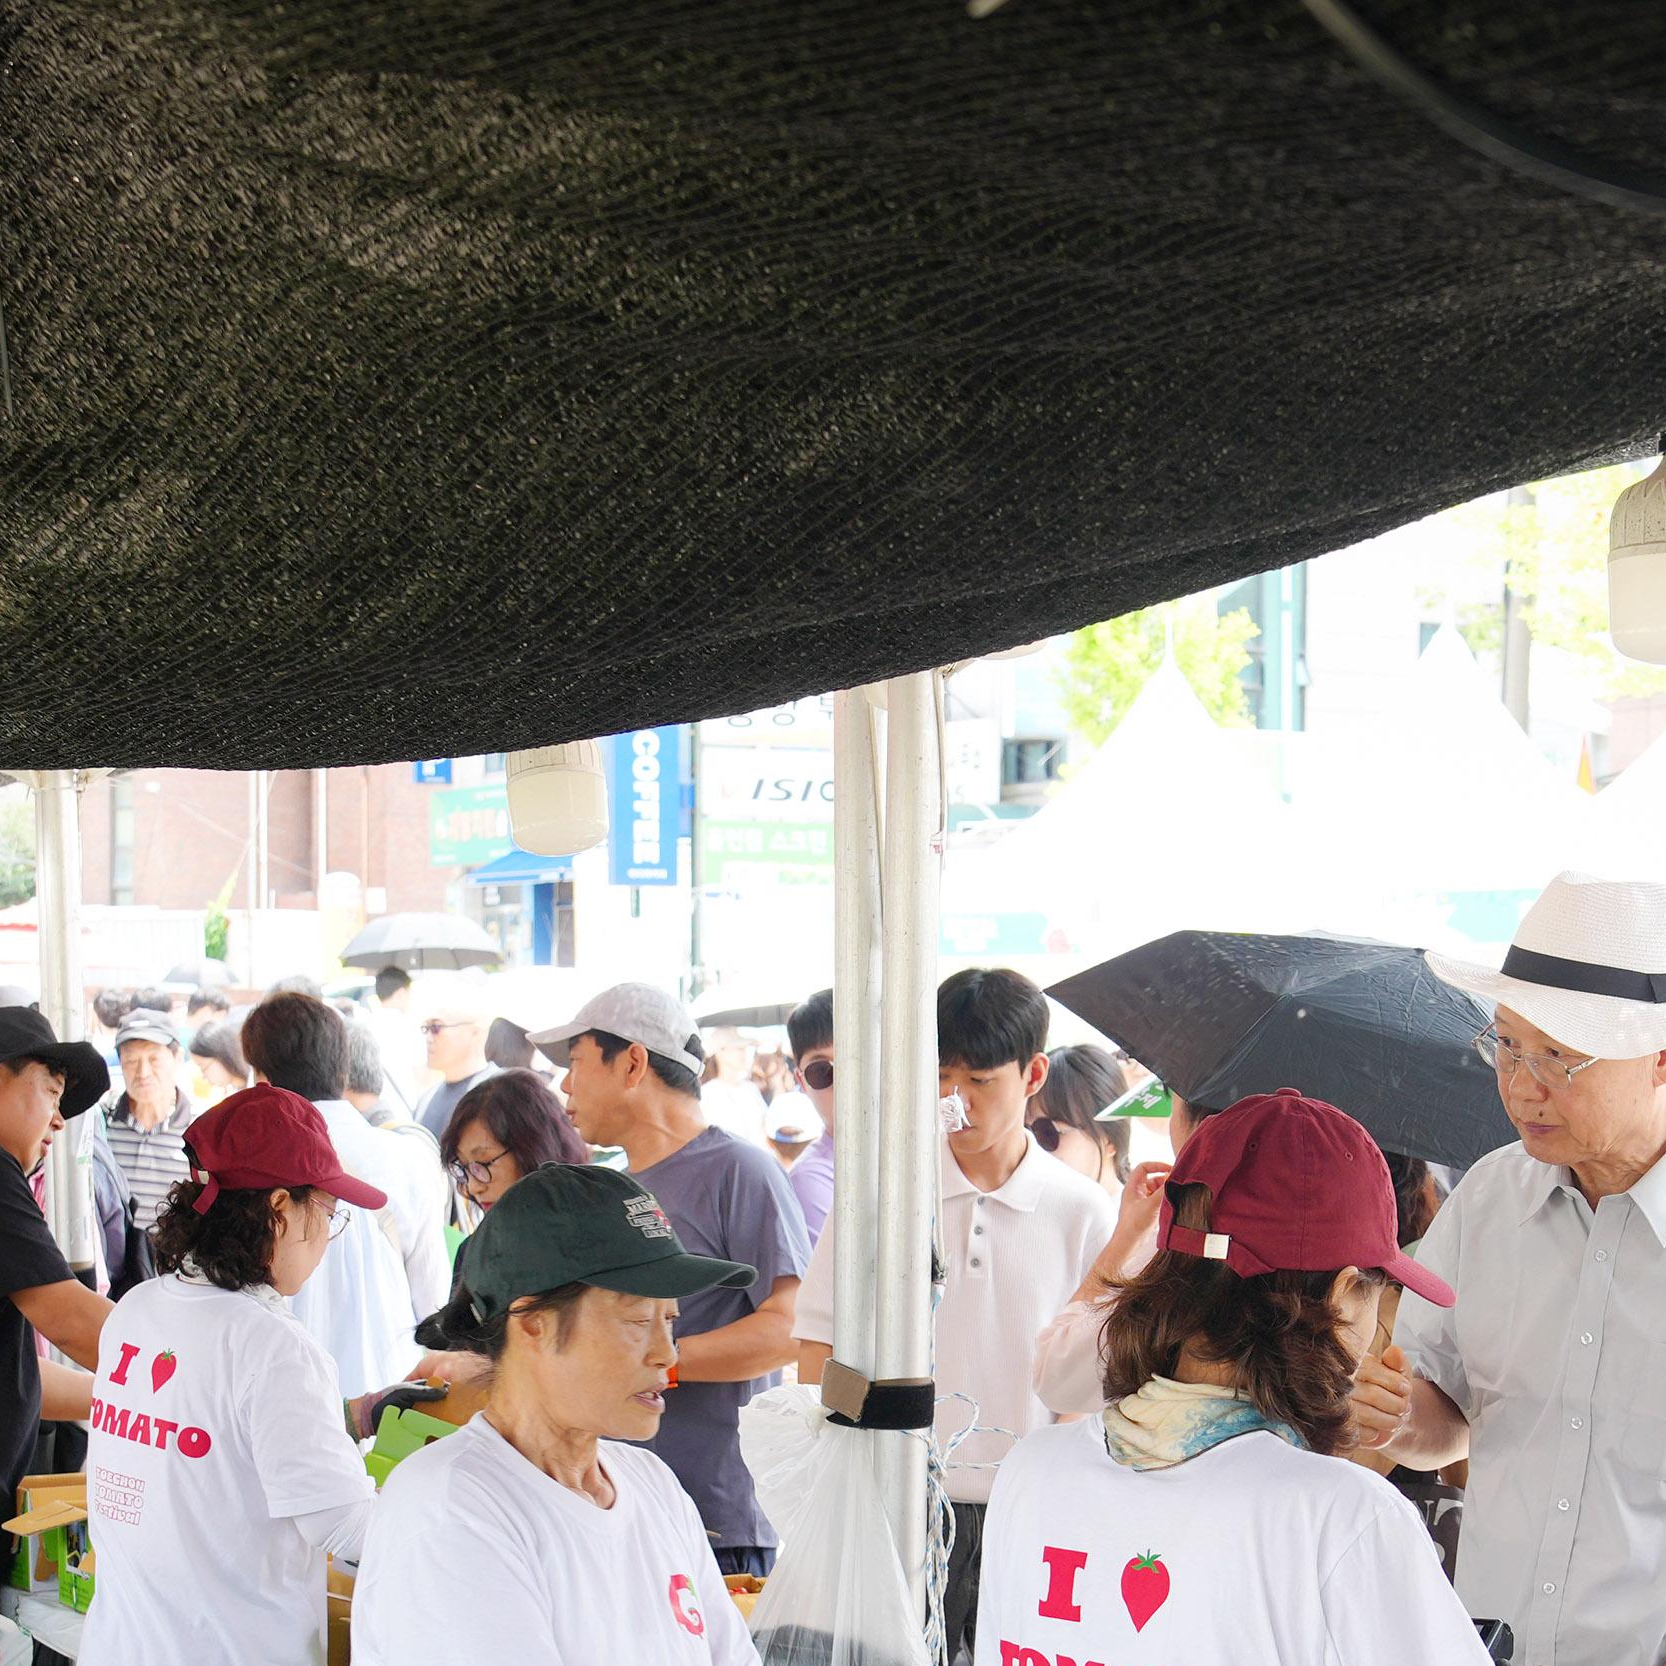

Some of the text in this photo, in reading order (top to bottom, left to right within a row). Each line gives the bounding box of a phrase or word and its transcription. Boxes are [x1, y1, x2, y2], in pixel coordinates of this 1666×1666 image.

[633, 730, 661, 865] COFFEE
[109, 1342, 141, 1386] I
[92, 1398, 212, 1459] OMATO
[1039, 1546, 1088, 1622] I
